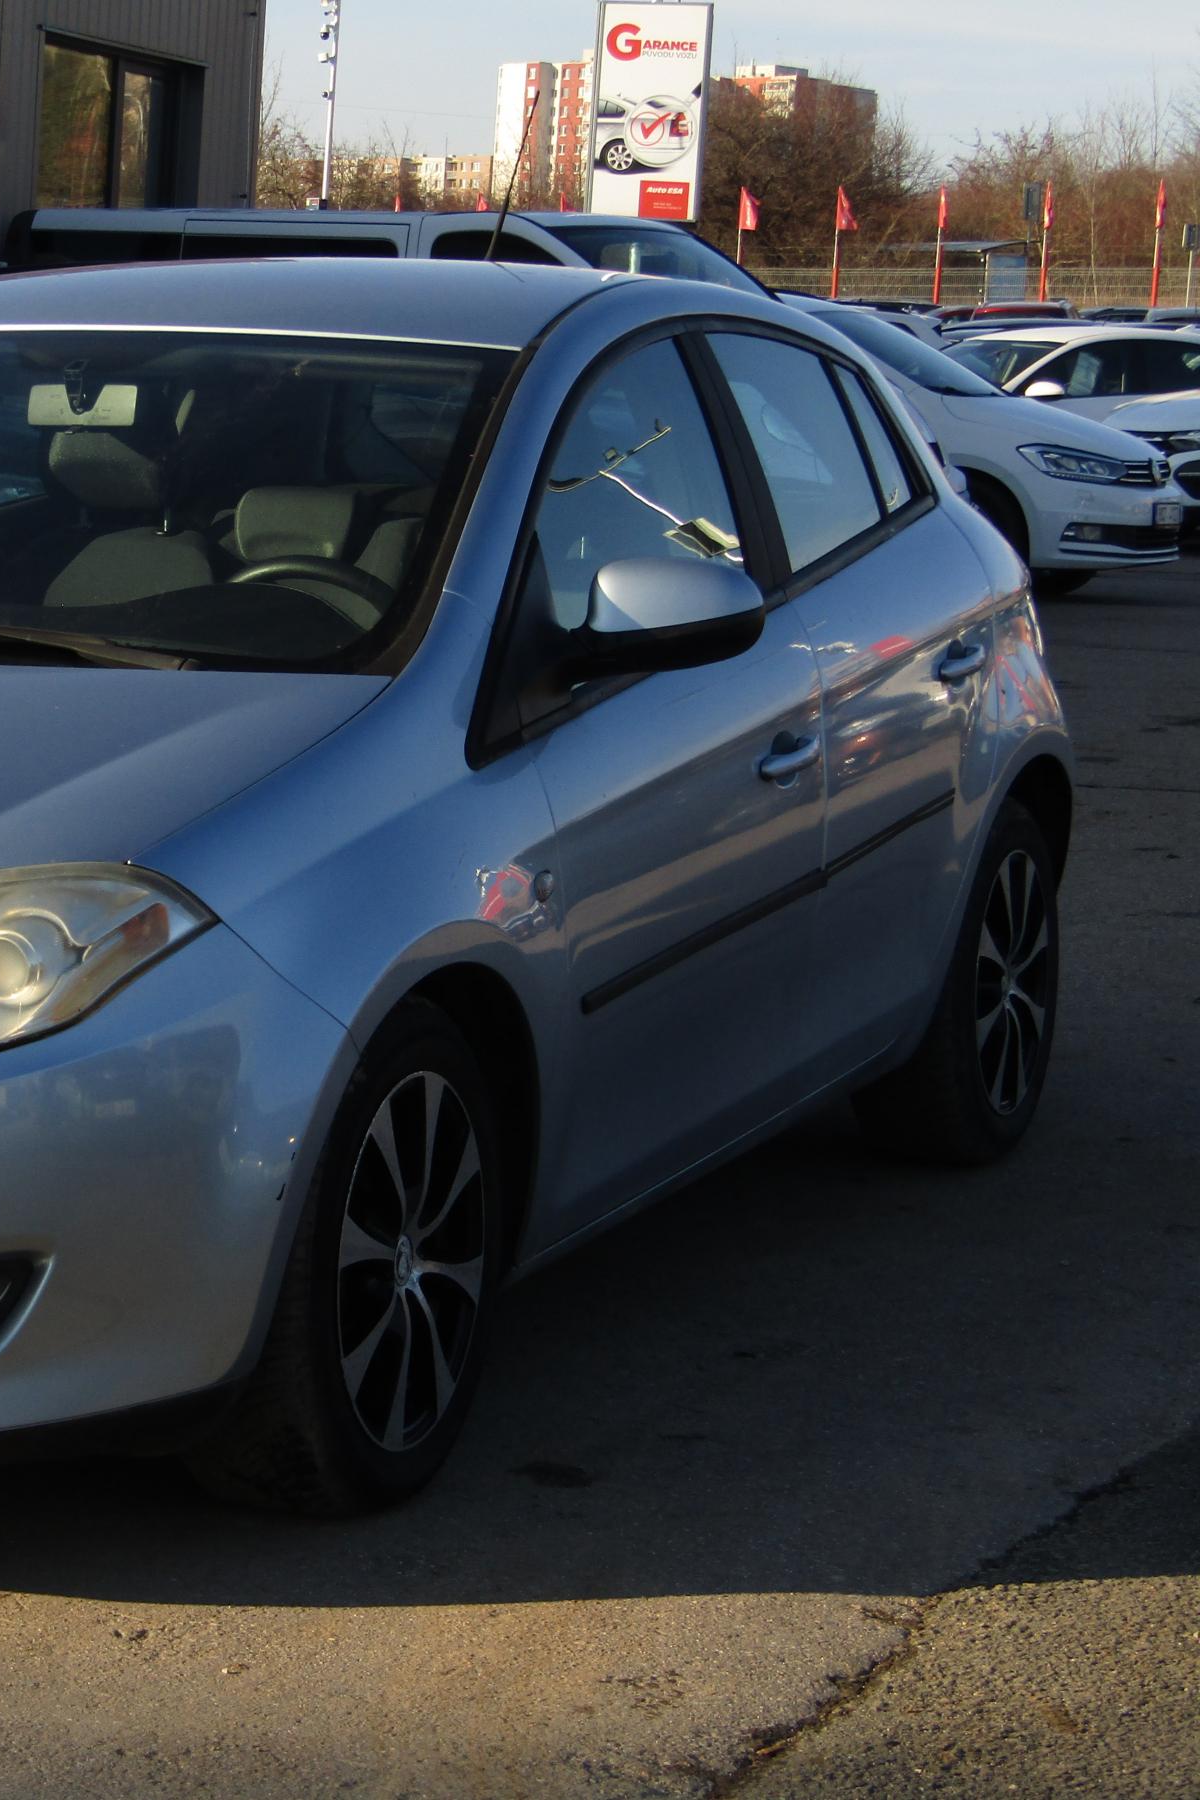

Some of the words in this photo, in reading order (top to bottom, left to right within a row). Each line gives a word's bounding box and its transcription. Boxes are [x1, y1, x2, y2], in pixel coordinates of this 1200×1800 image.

[606, 23, 697, 61] GARANCE
[646, 186, 666, 194] Auto
[667, 187, 683, 195] ESA
